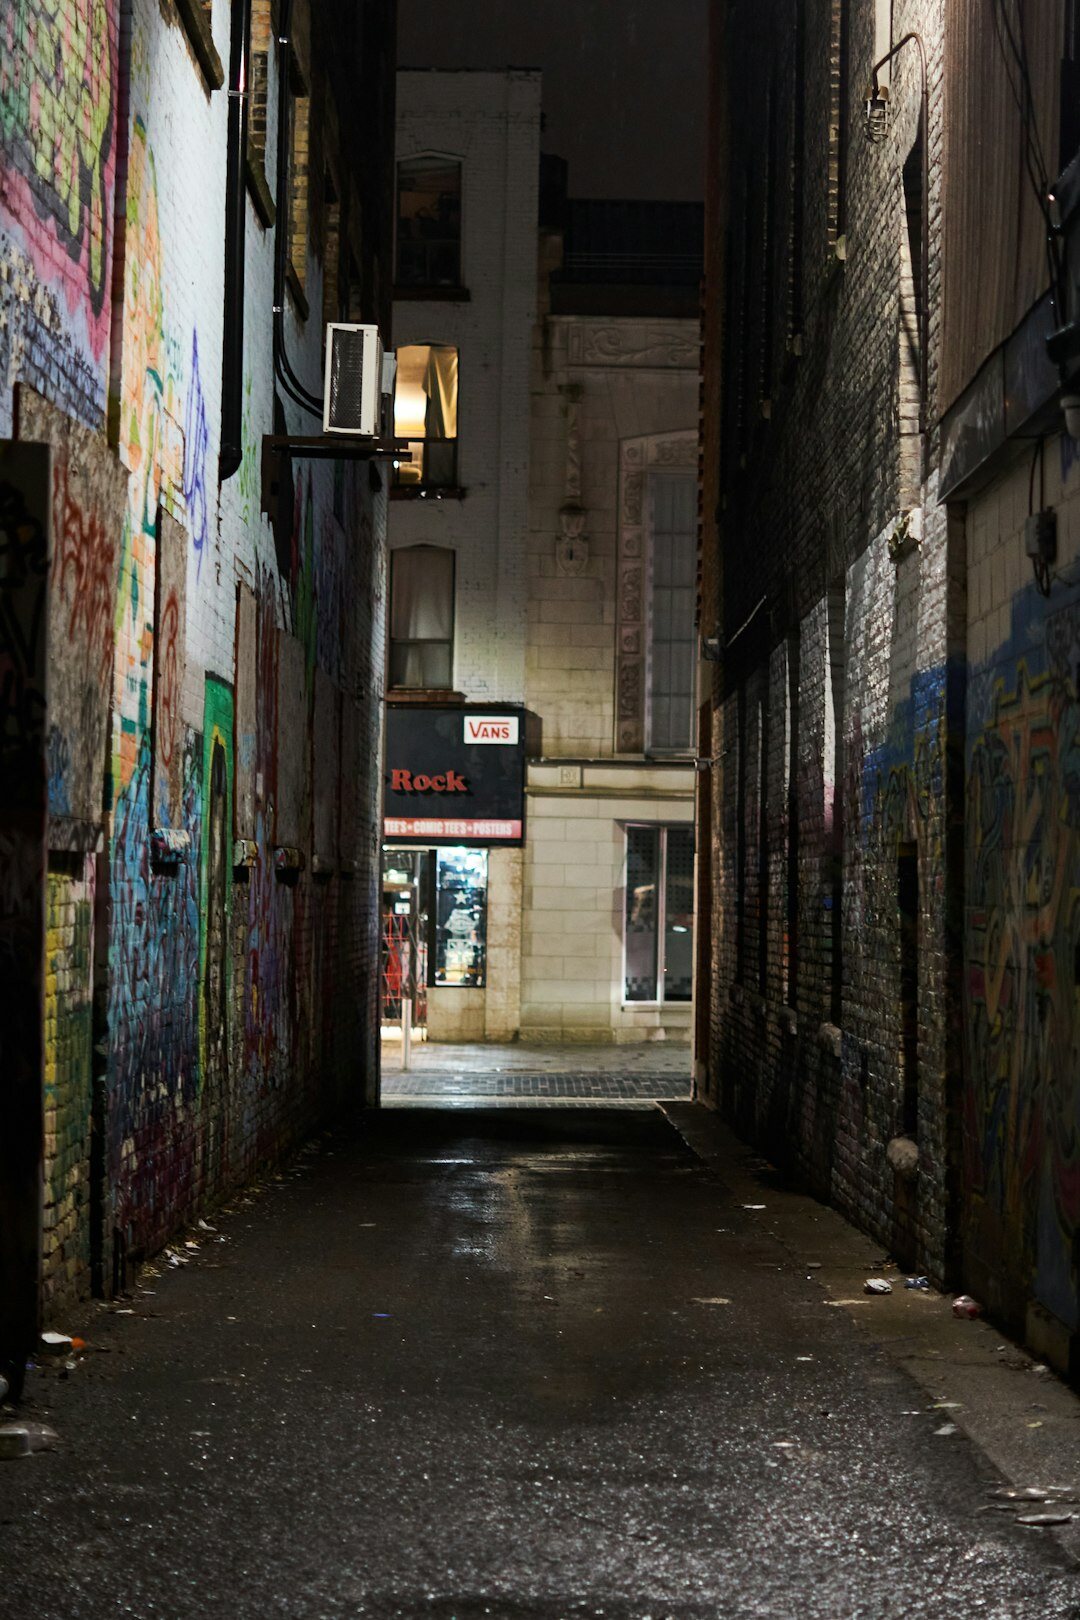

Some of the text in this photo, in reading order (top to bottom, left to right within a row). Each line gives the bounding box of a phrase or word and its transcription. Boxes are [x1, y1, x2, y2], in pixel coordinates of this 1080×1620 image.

[469, 722, 510, 739] VANS
[391, 769, 468, 792] Rock
[473, 822, 512, 835] POSTERS
